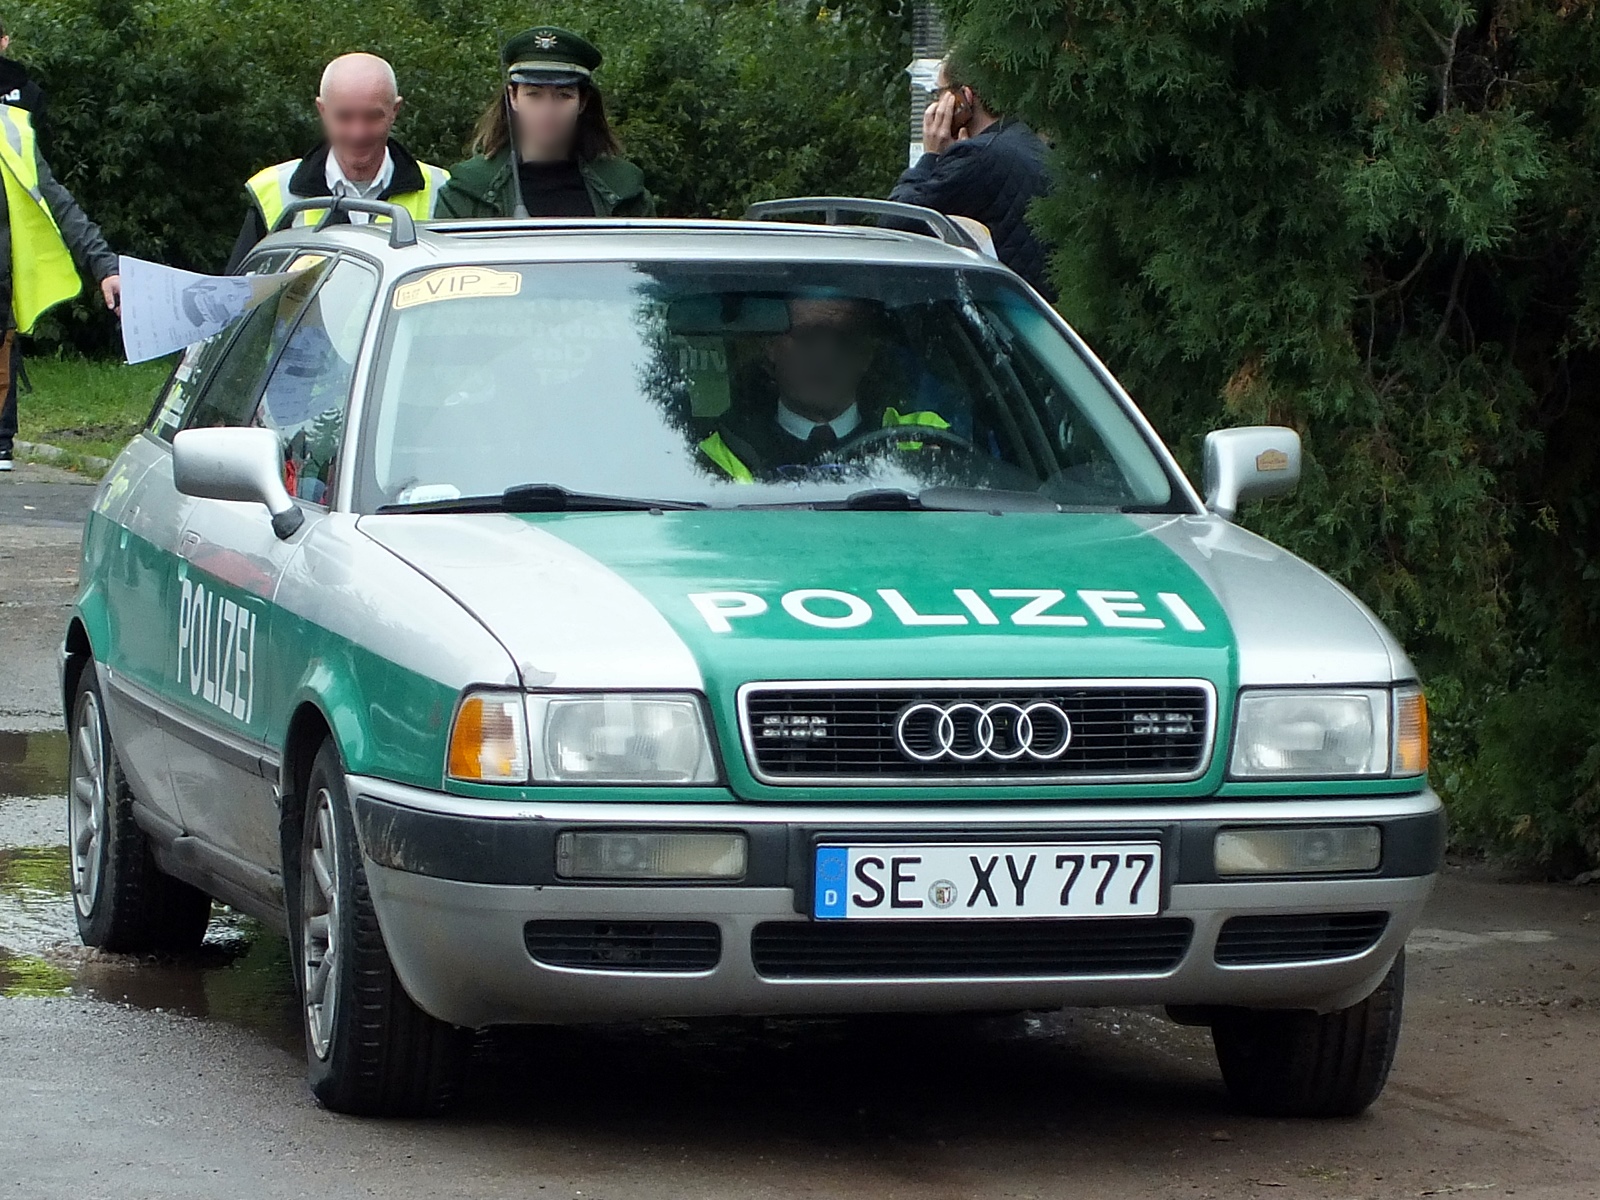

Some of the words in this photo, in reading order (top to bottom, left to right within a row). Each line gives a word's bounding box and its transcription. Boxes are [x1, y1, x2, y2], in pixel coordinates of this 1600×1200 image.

[426, 275, 481, 294] VIP
[687, 588, 1206, 634] POLIZEI
[177, 578, 256, 724] POLIZEI
[824, 890, 837, 906] D
[852, 856, 924, 909] SE
[966, 854, 1037, 908] XY
[1055, 854, 1155, 906] 777
